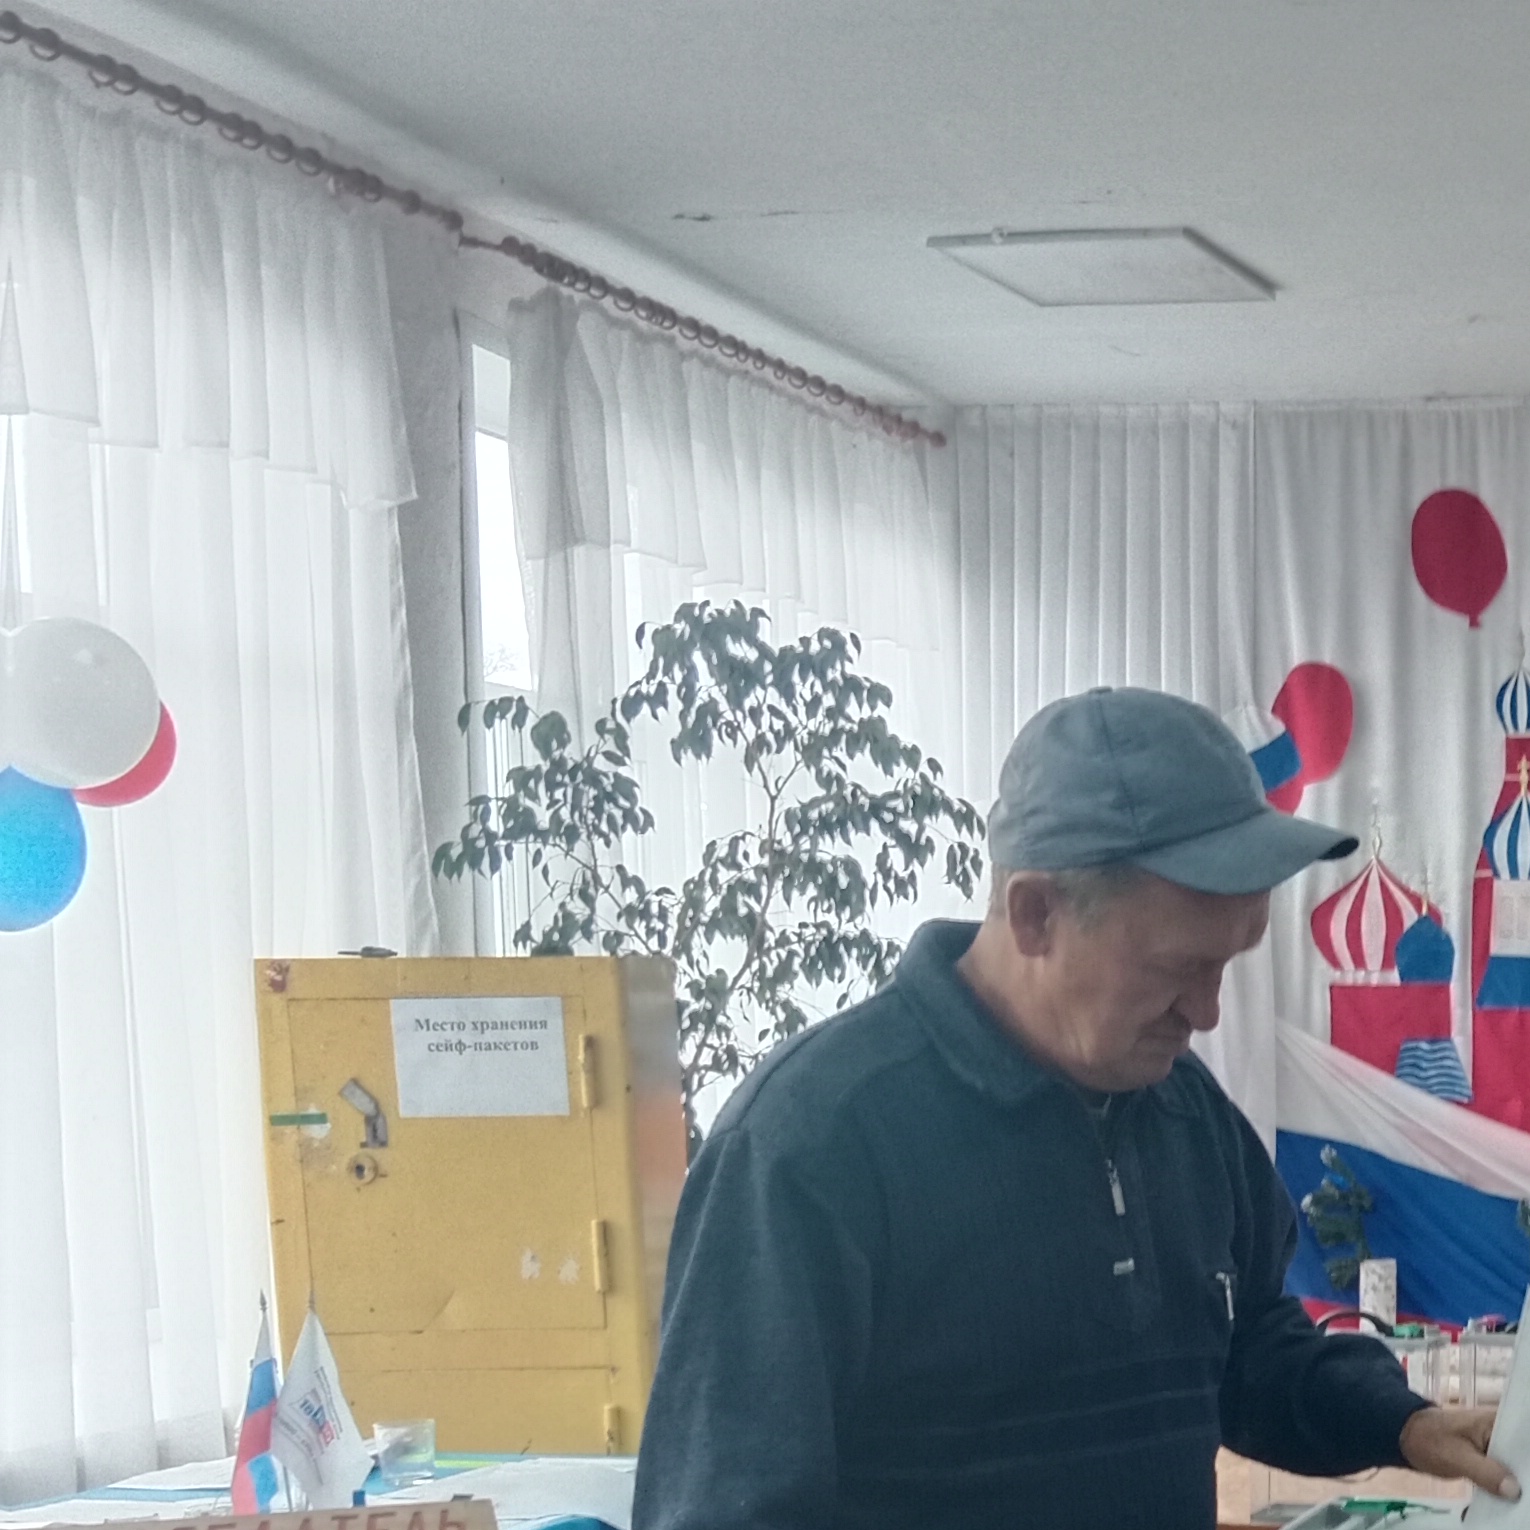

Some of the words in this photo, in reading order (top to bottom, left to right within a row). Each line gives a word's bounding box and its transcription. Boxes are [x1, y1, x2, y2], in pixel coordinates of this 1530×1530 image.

[414, 1018, 466, 1032] Место
[471, 1018, 548, 1034] хранения
[427, 1039, 539, 1055] сейф-пакетов
